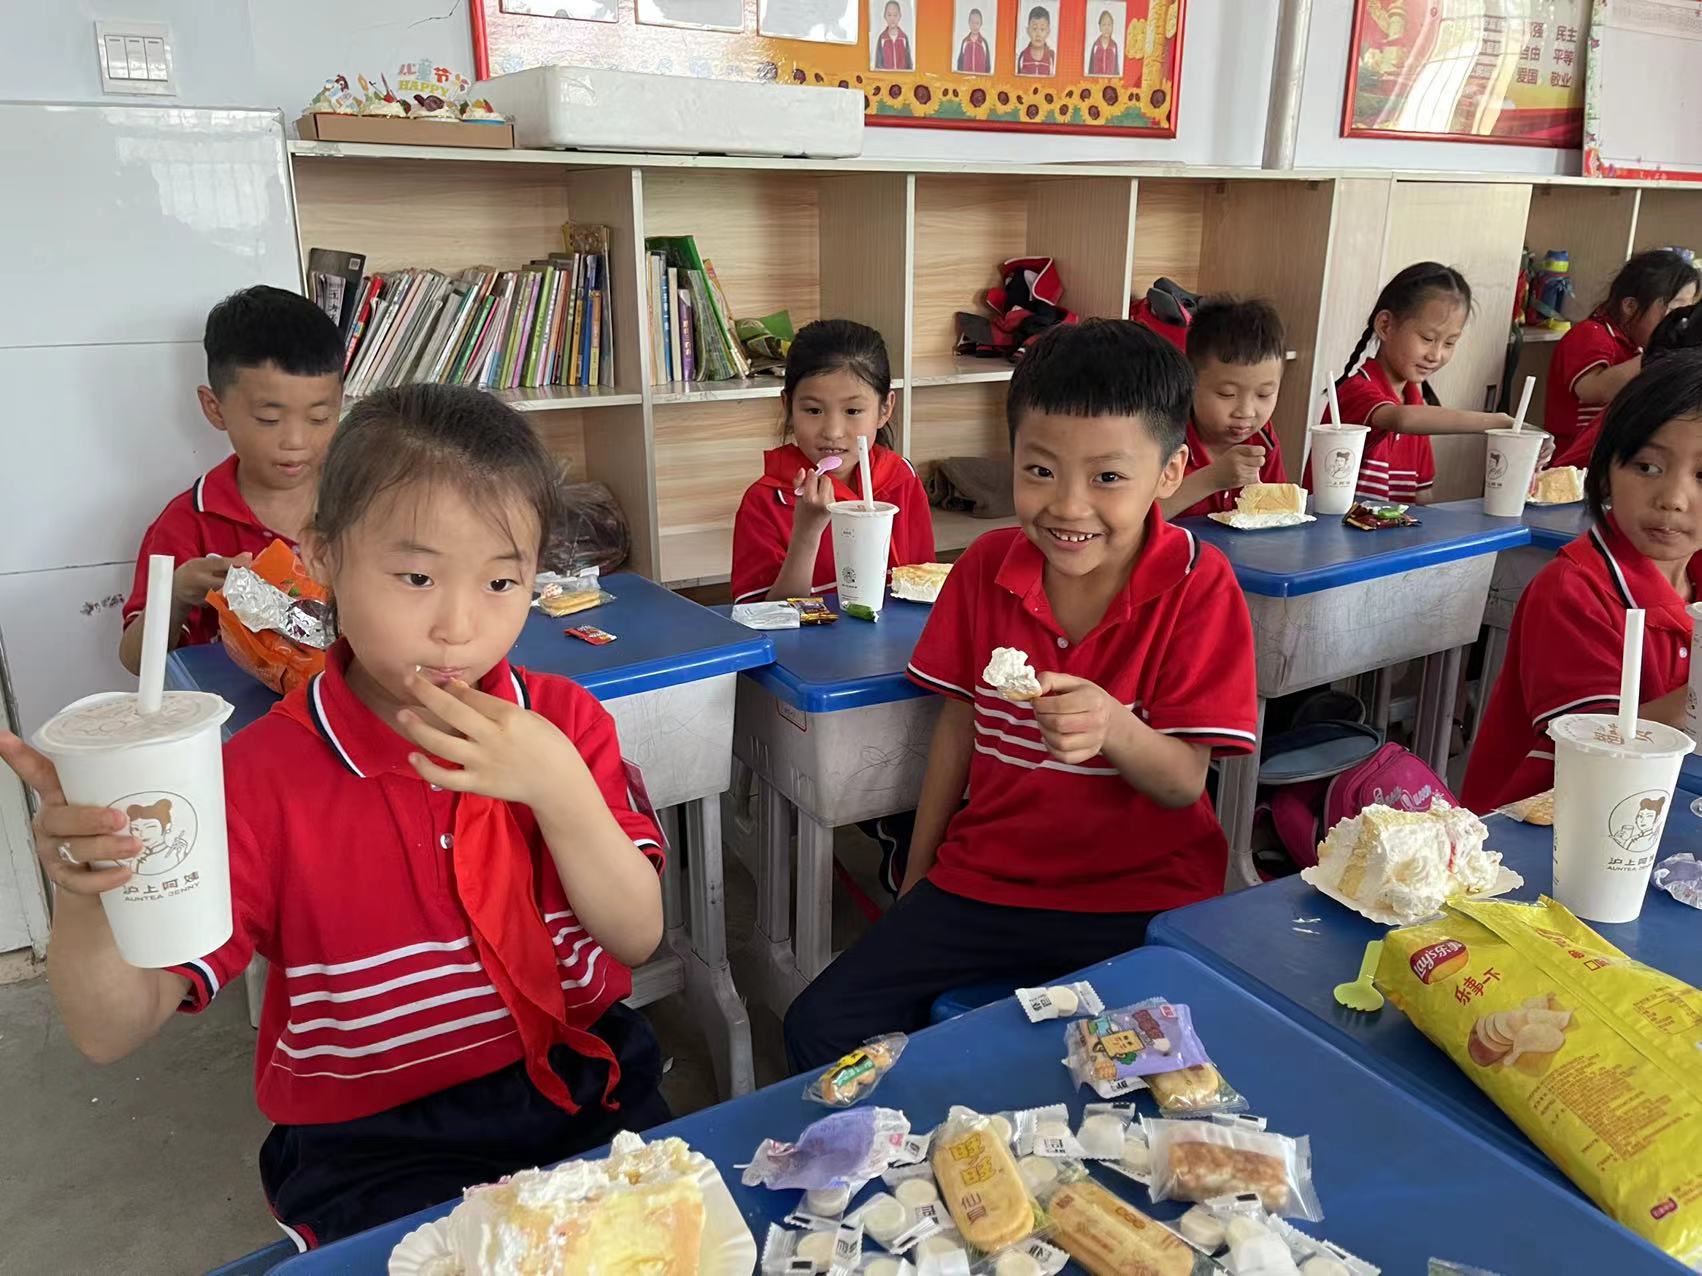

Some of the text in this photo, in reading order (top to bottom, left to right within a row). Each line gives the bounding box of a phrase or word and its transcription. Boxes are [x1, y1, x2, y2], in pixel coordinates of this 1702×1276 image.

[1556, 25, 1578, 43] 民主
[1553, 48, 1575, 66] 平等
[1516, 67, 1573, 88] 爱国 敬业
[399, 80, 449, 97] HAPPY
